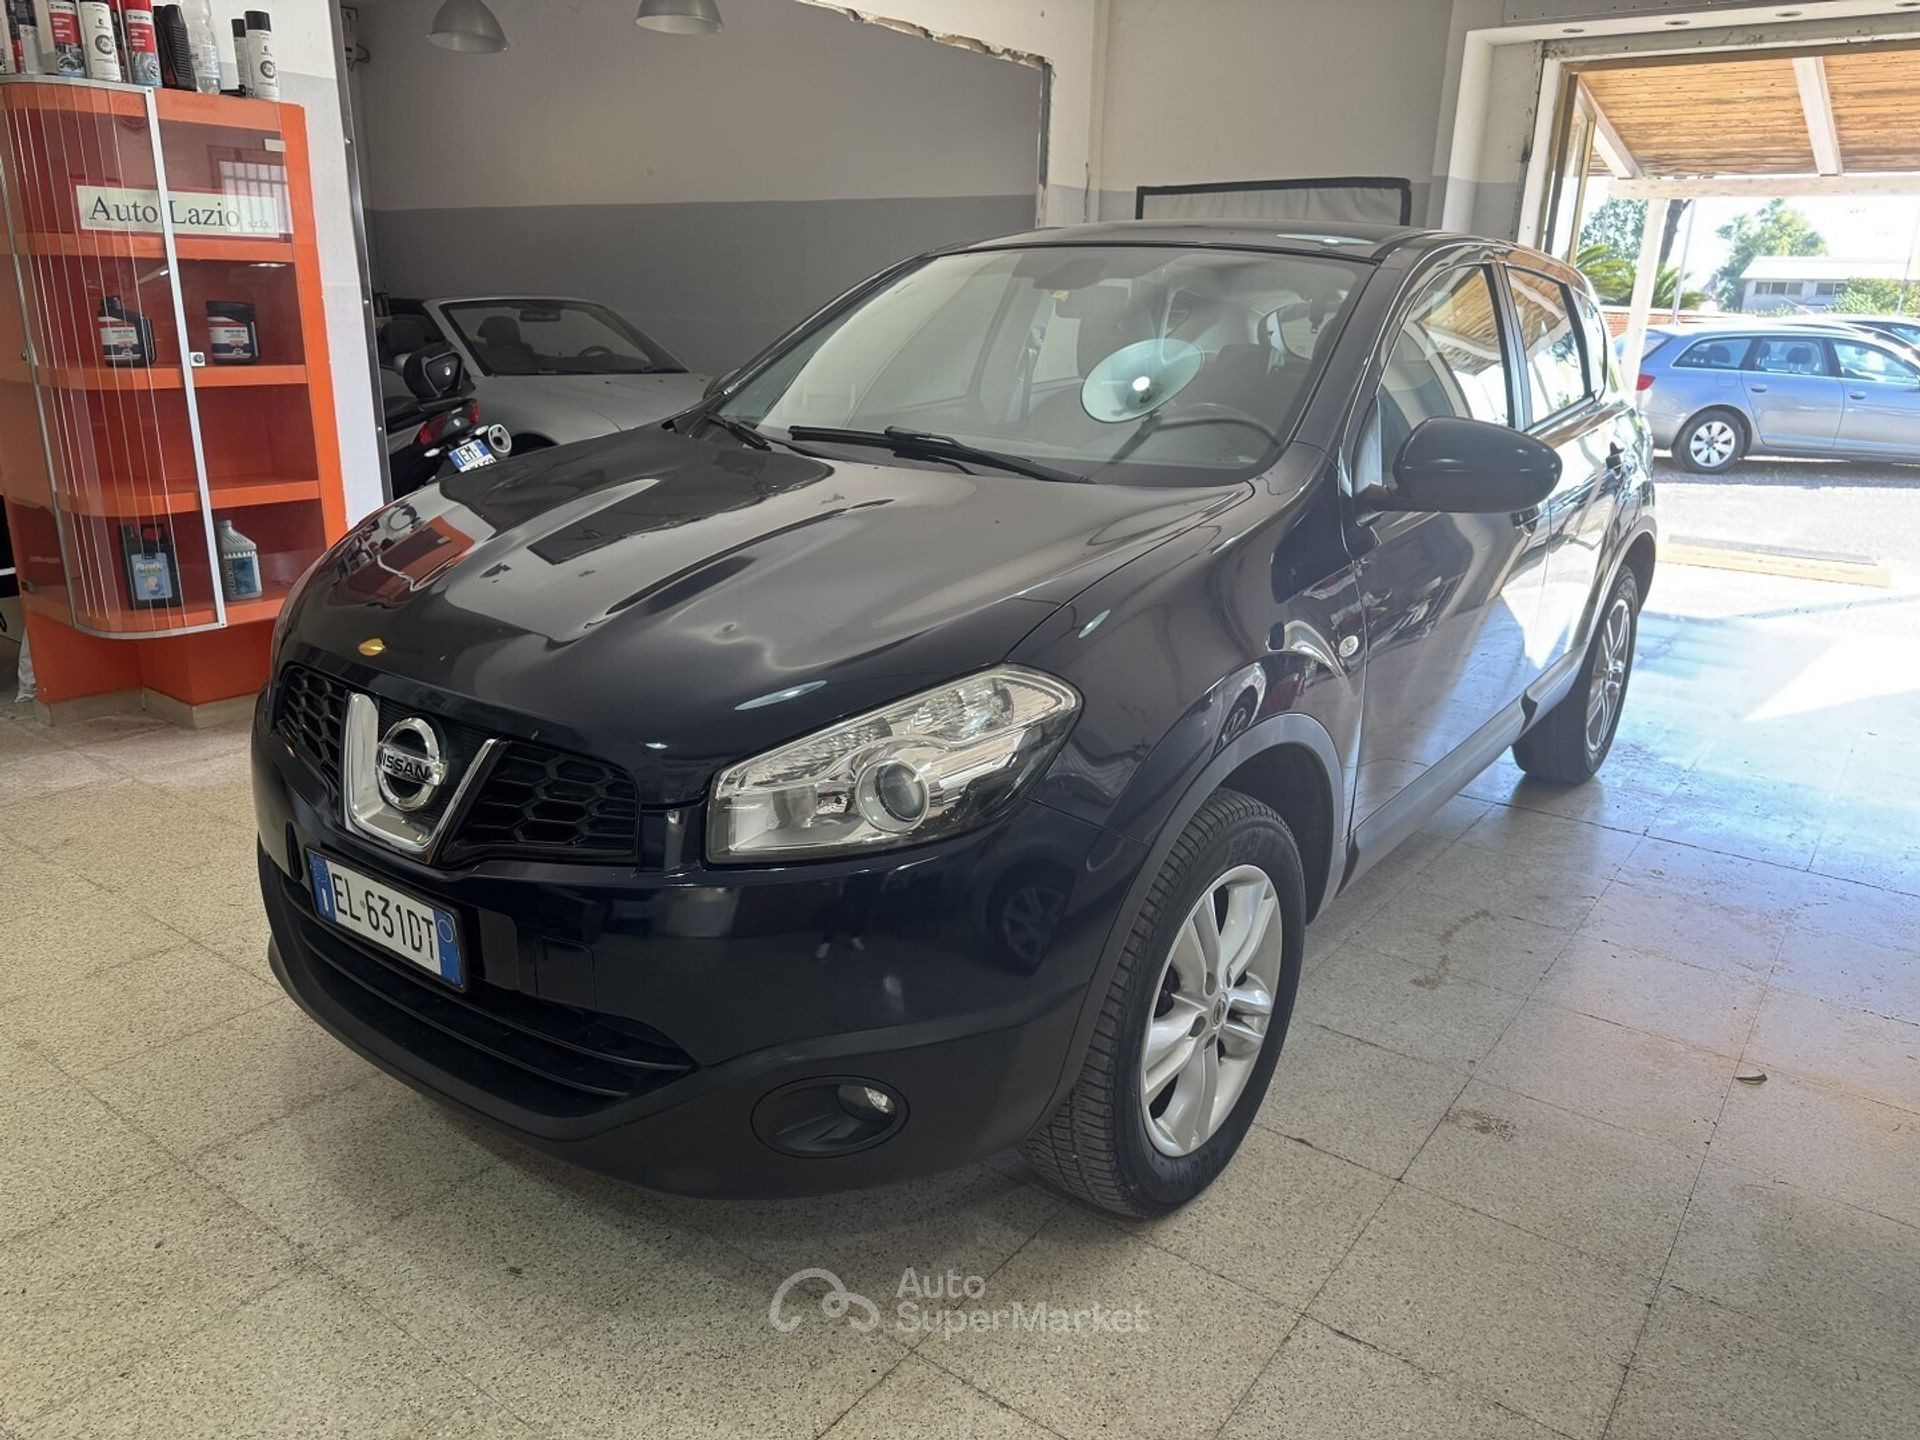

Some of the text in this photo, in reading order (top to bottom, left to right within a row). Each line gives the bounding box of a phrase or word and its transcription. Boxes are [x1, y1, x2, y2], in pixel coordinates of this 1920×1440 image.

[89, 195, 158, 223] Auto
[168, 199, 240, 227] Lazio
[377, 751, 431, 780] NISSAN
[331, 872, 361, 922] EL
